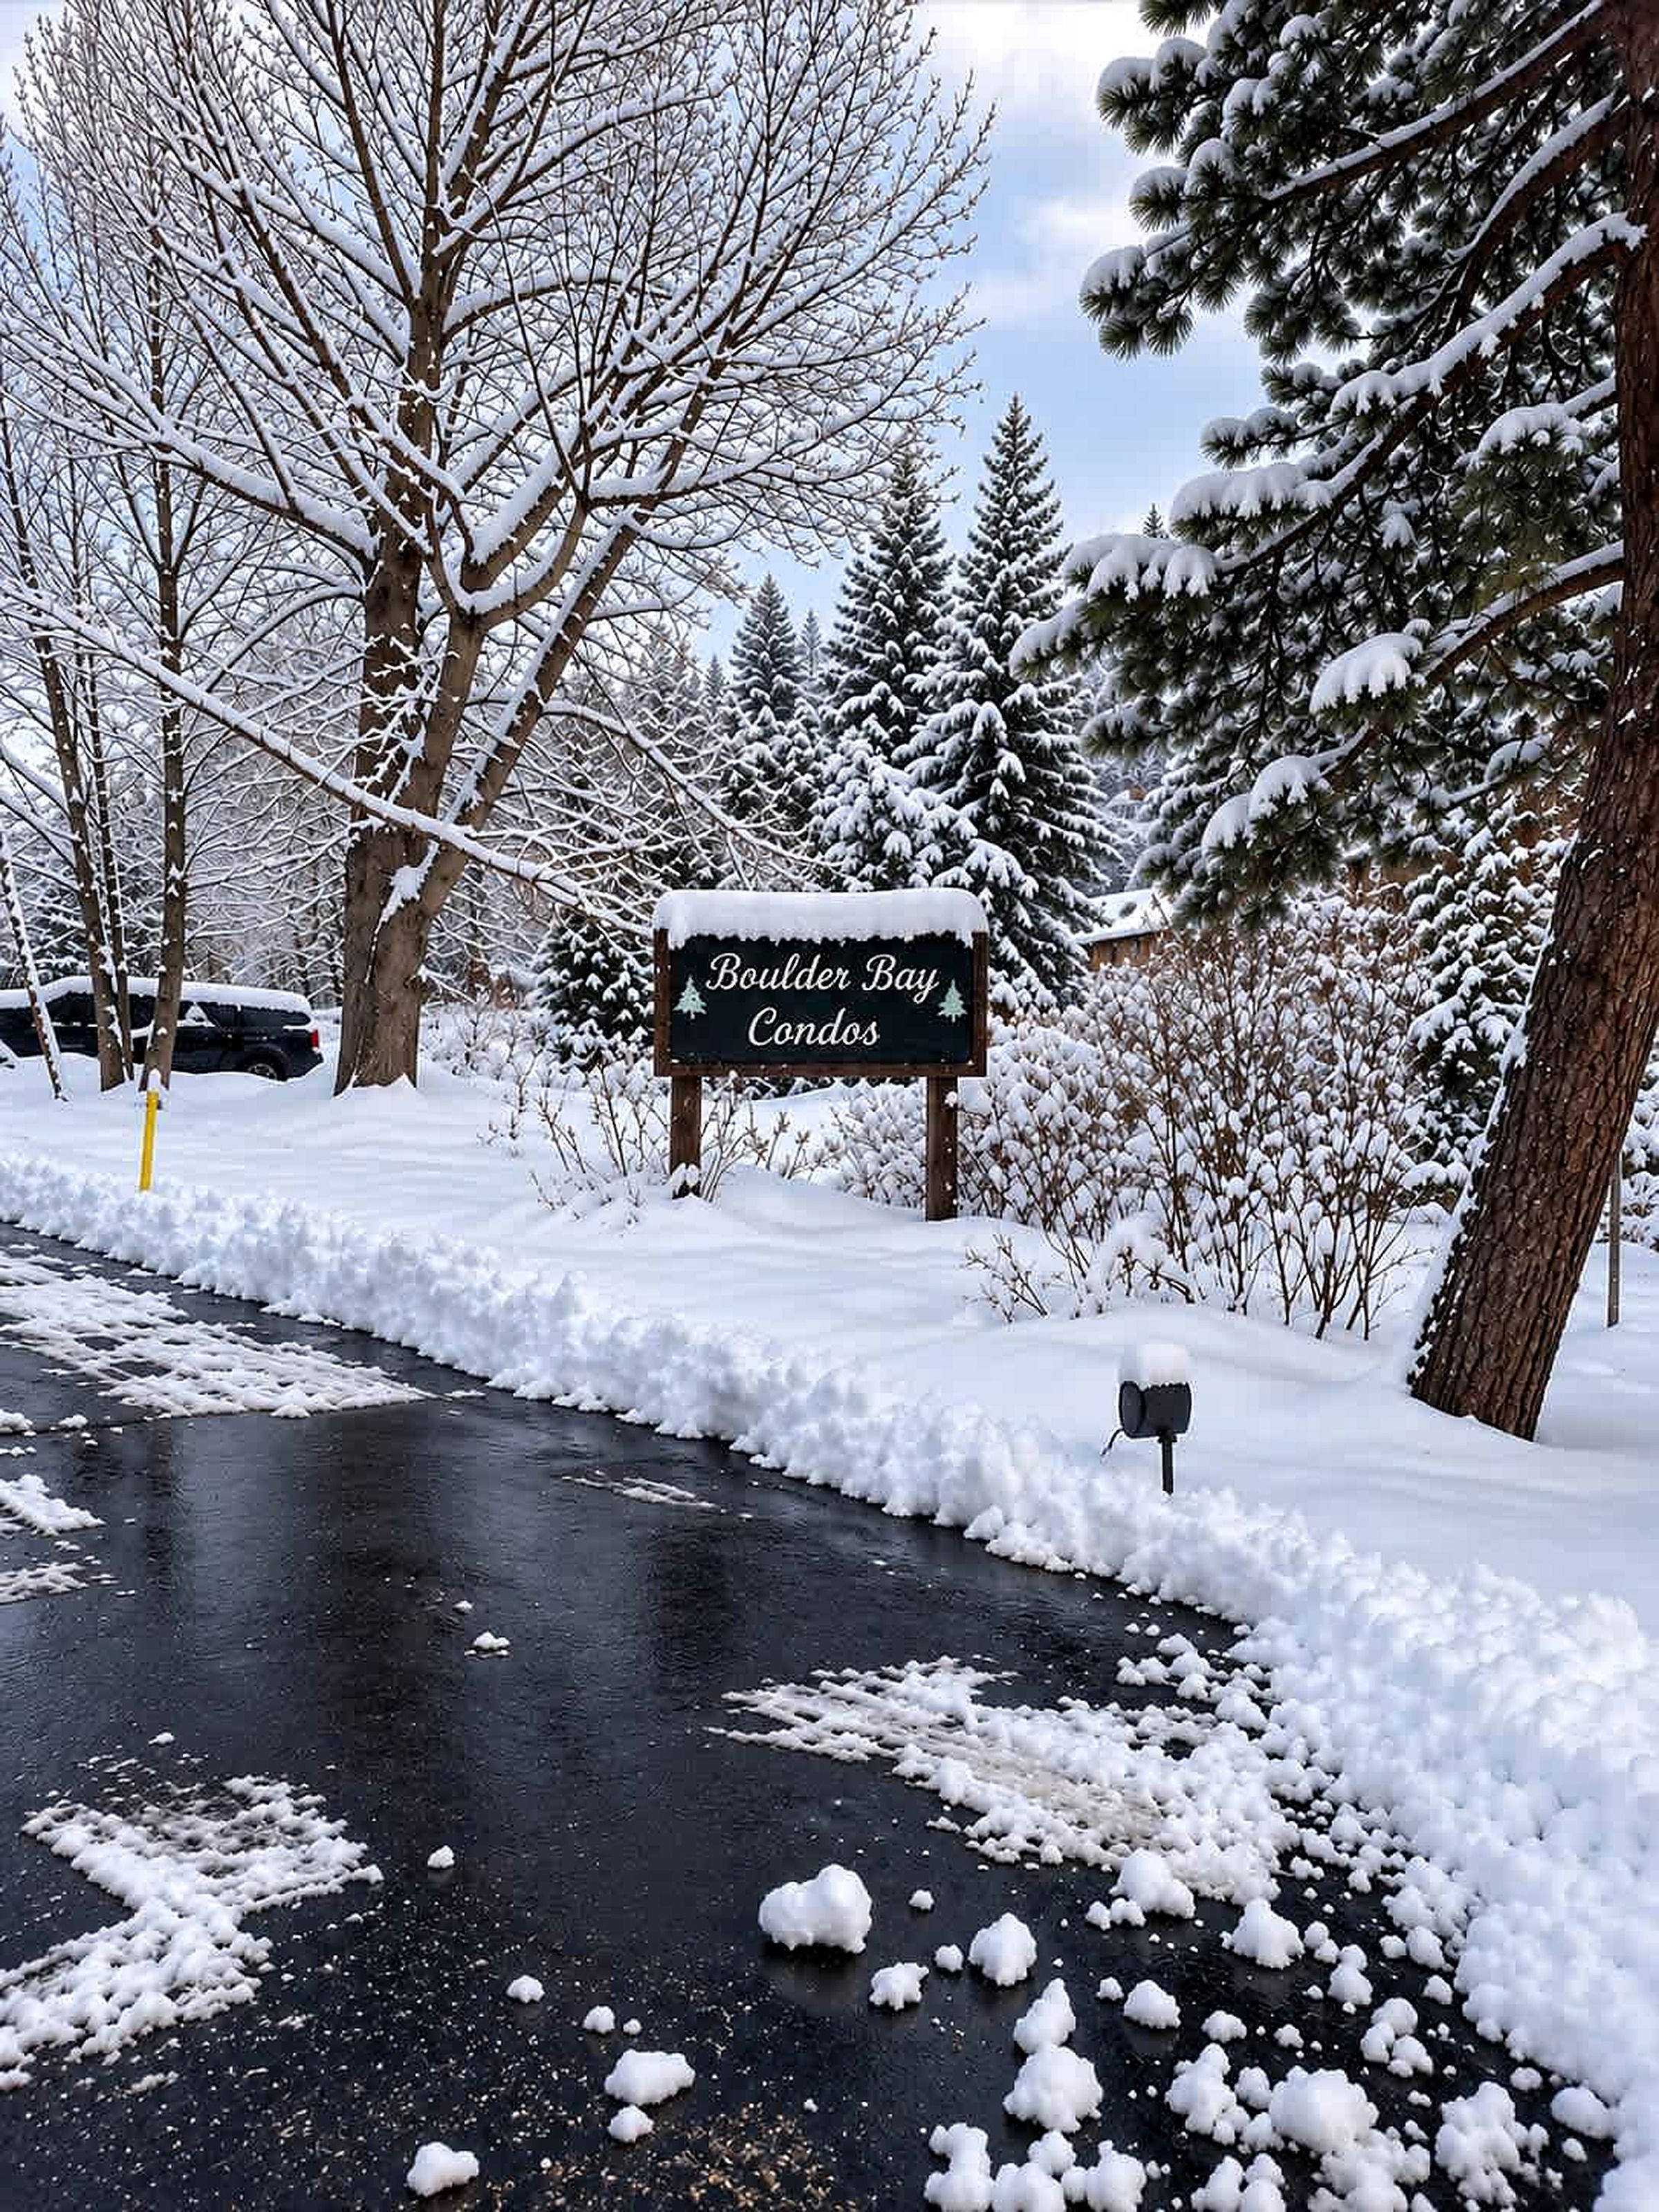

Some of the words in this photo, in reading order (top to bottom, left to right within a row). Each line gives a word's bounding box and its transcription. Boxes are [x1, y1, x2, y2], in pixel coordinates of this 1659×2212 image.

[705, 953, 851, 991] Boulder
[861, 954, 939, 1004] Bay
[748, 1006, 881, 1046] Condos
